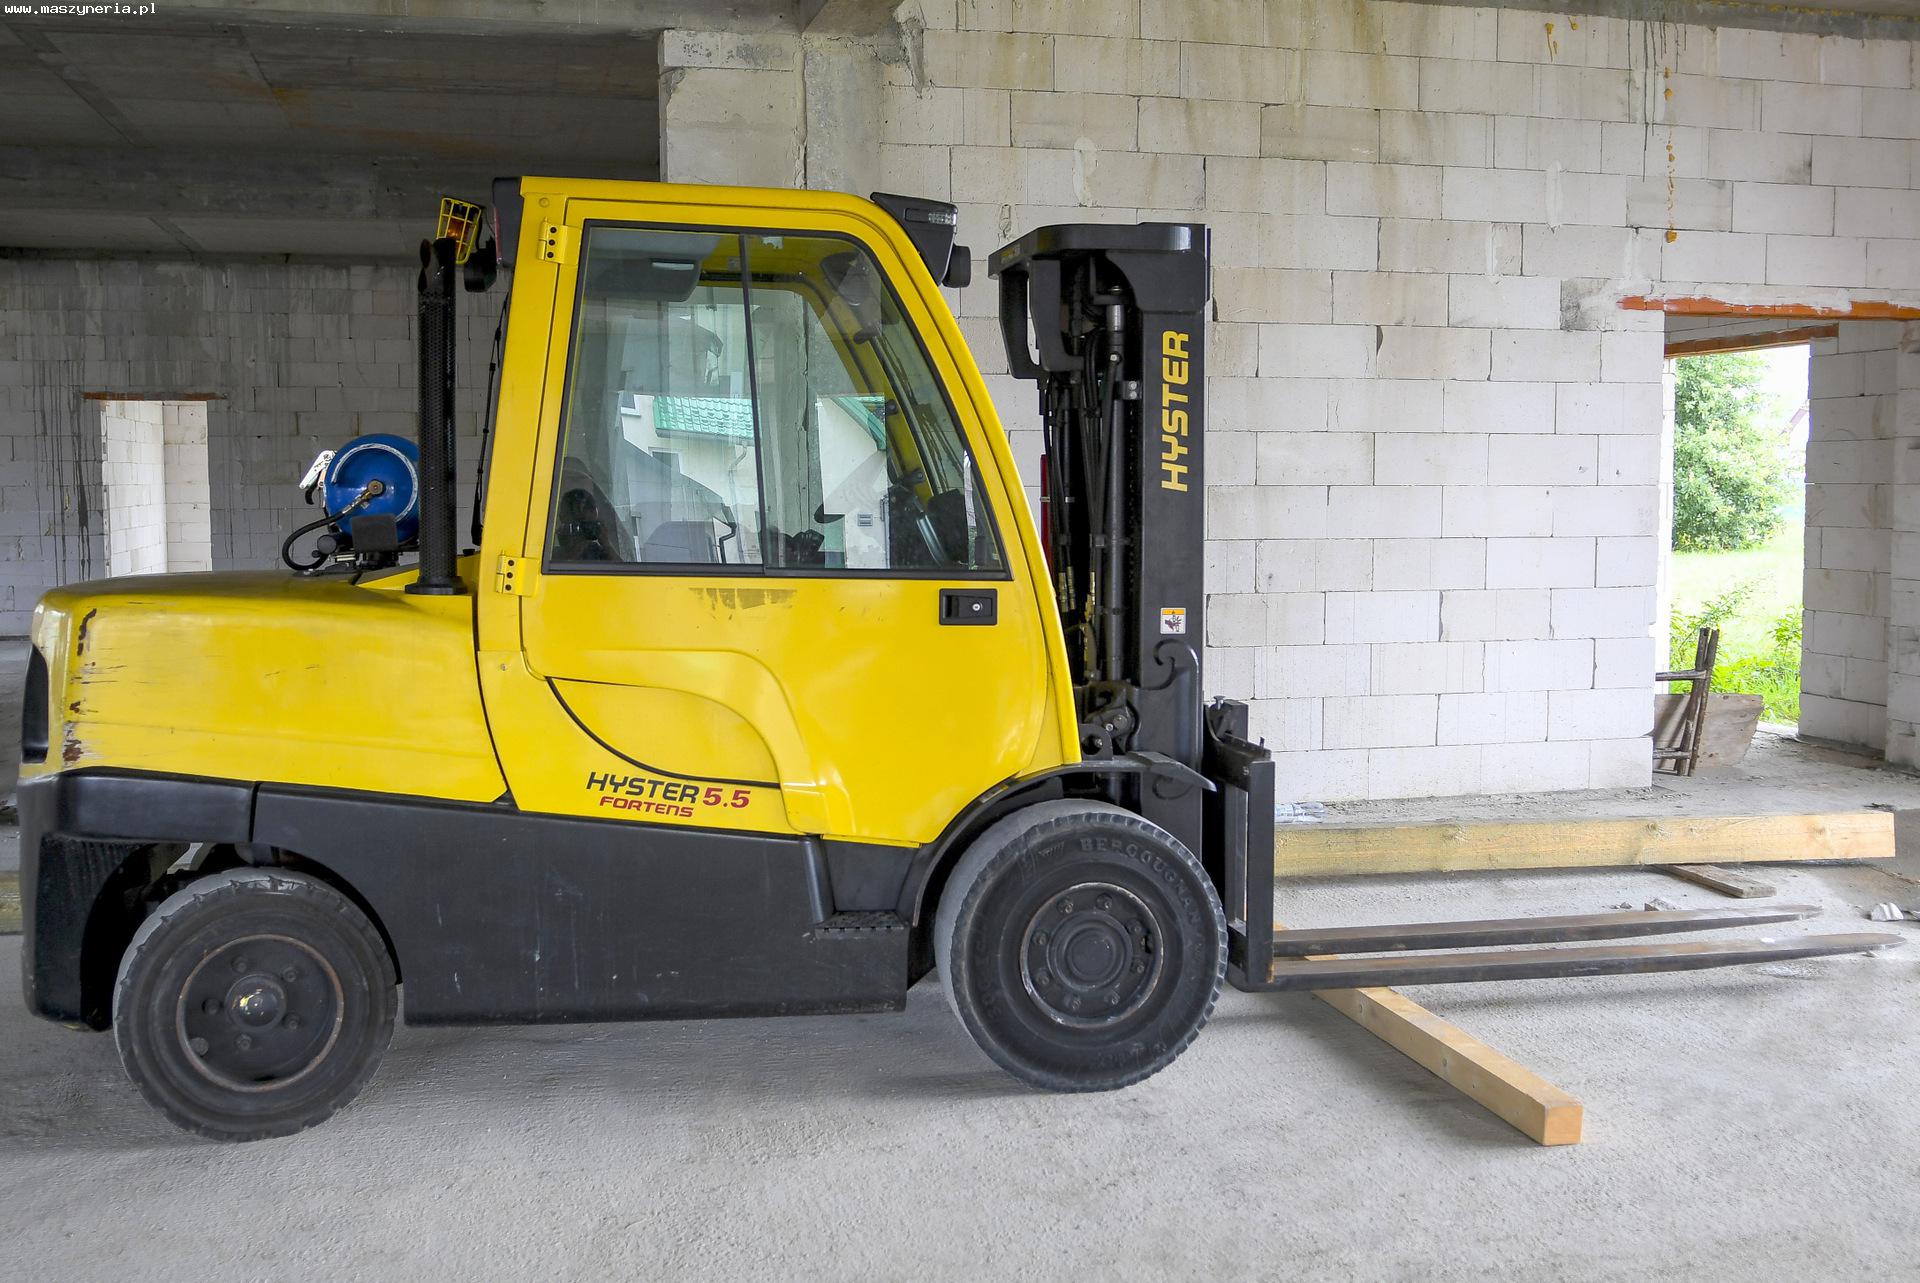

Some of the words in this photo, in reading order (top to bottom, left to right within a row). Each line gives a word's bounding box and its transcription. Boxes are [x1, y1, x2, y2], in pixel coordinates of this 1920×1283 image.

[1161, 330, 1190, 493] HYSTER
[586, 771, 700, 804] HYSTER
[702, 787, 751, 809] 5.5
[599, 796, 695, 818] FORTENS
